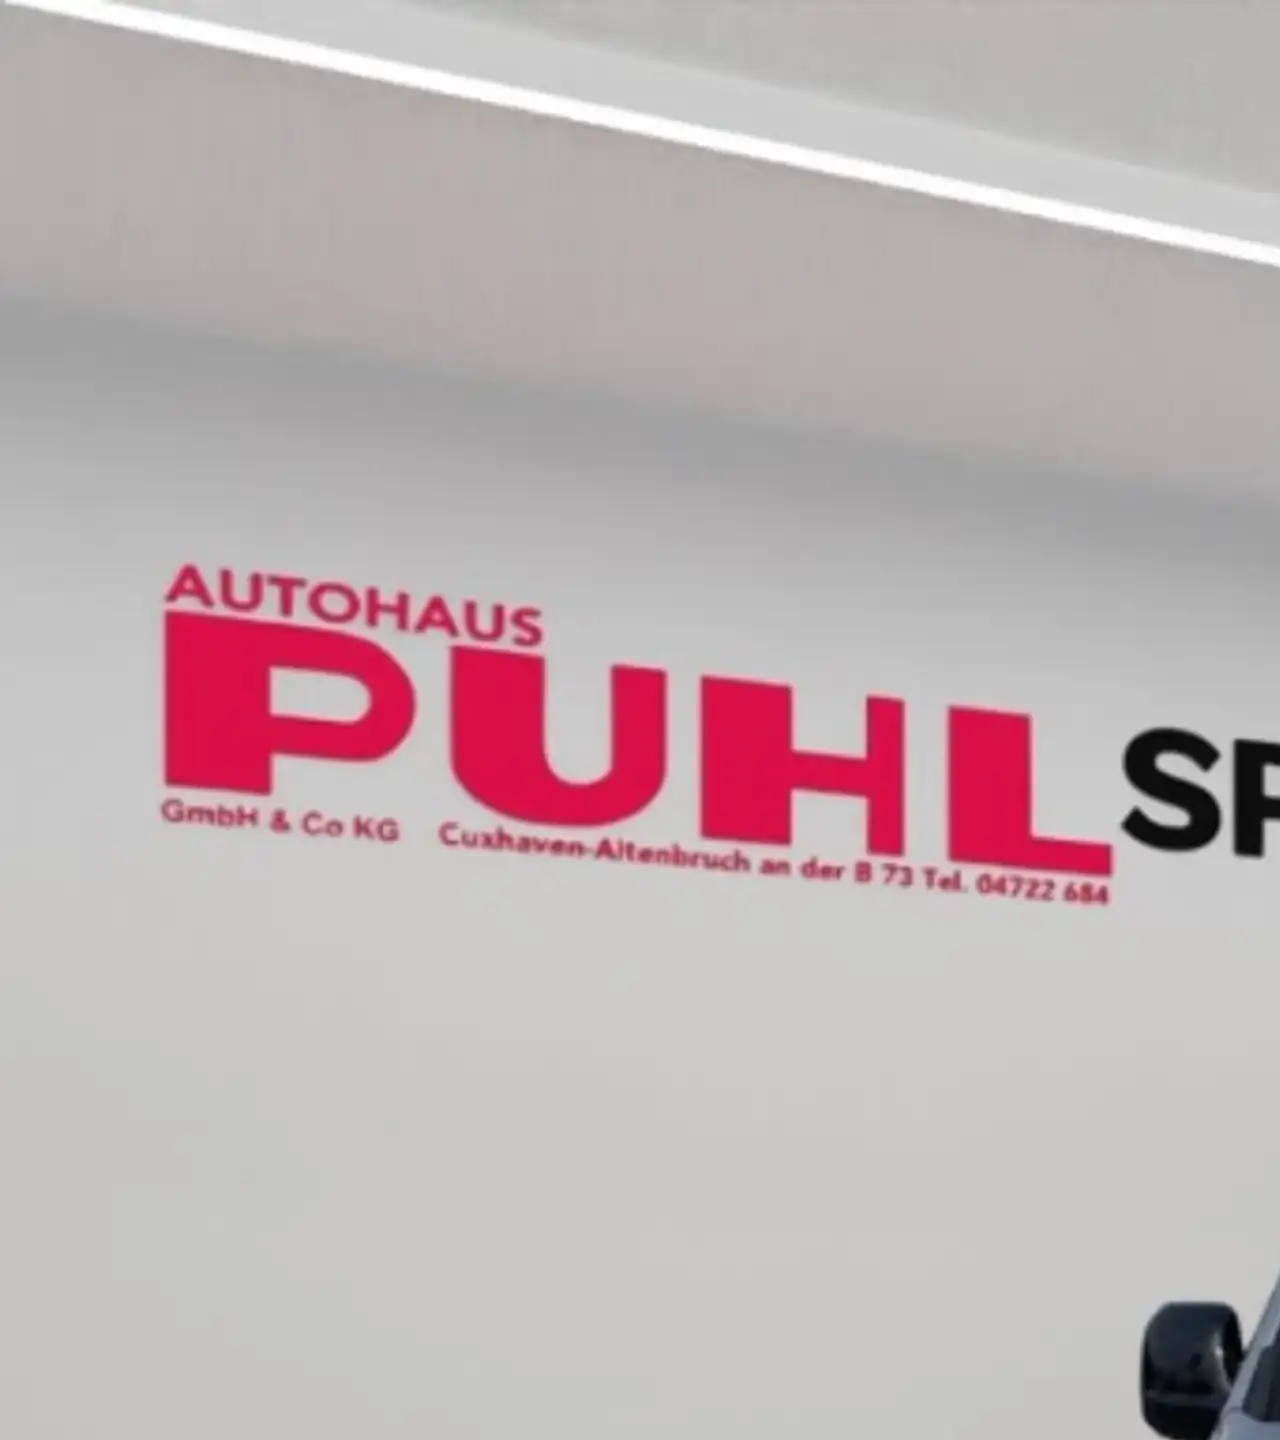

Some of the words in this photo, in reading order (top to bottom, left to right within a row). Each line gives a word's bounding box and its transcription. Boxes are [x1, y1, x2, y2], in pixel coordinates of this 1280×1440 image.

[164, 563, 544, 647] AUTOHAUS
[164, 610, 1114, 878] PUHL
[161, 798, 259, 829] GmbH
[269, 809, 292, 834] &
[302, 810, 344, 836] Co
[353, 815, 399, 842] KG
[437, 821, 751, 873] Cuxhaven-Altenbruch
[760, 857, 791, 876] an
[800, 856, 845, 881] der
[854, 861, 872, 883] B
[882, 864, 913, 888] 73
[922, 866, 968, 893] Tel.
[976, 873, 1056, 901] 04722
[1063, 882, 1110, 906] 684
